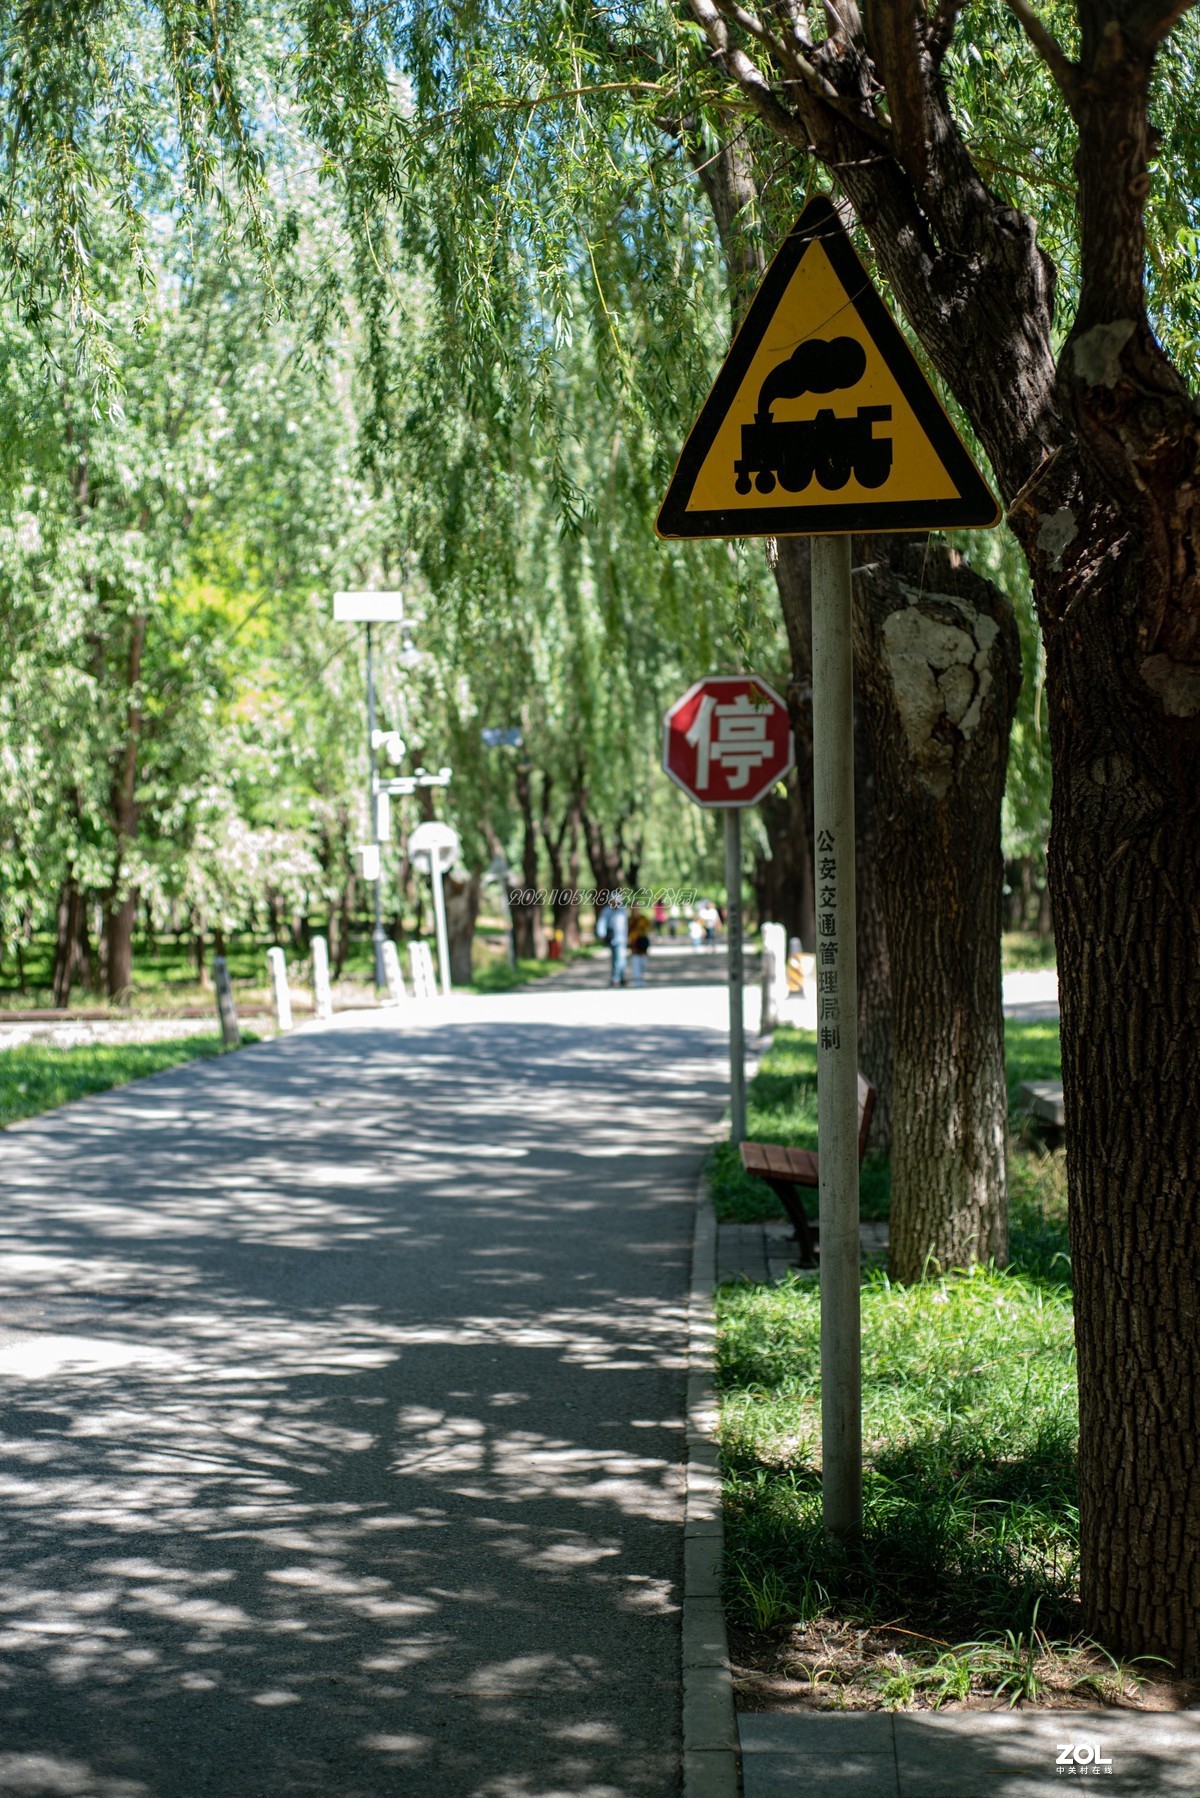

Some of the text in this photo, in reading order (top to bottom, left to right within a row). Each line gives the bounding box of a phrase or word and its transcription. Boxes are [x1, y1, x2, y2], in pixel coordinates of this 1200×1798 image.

[685, 694, 774, 790] 停
[817, 829, 841, 1050] 公安交通管理局制
